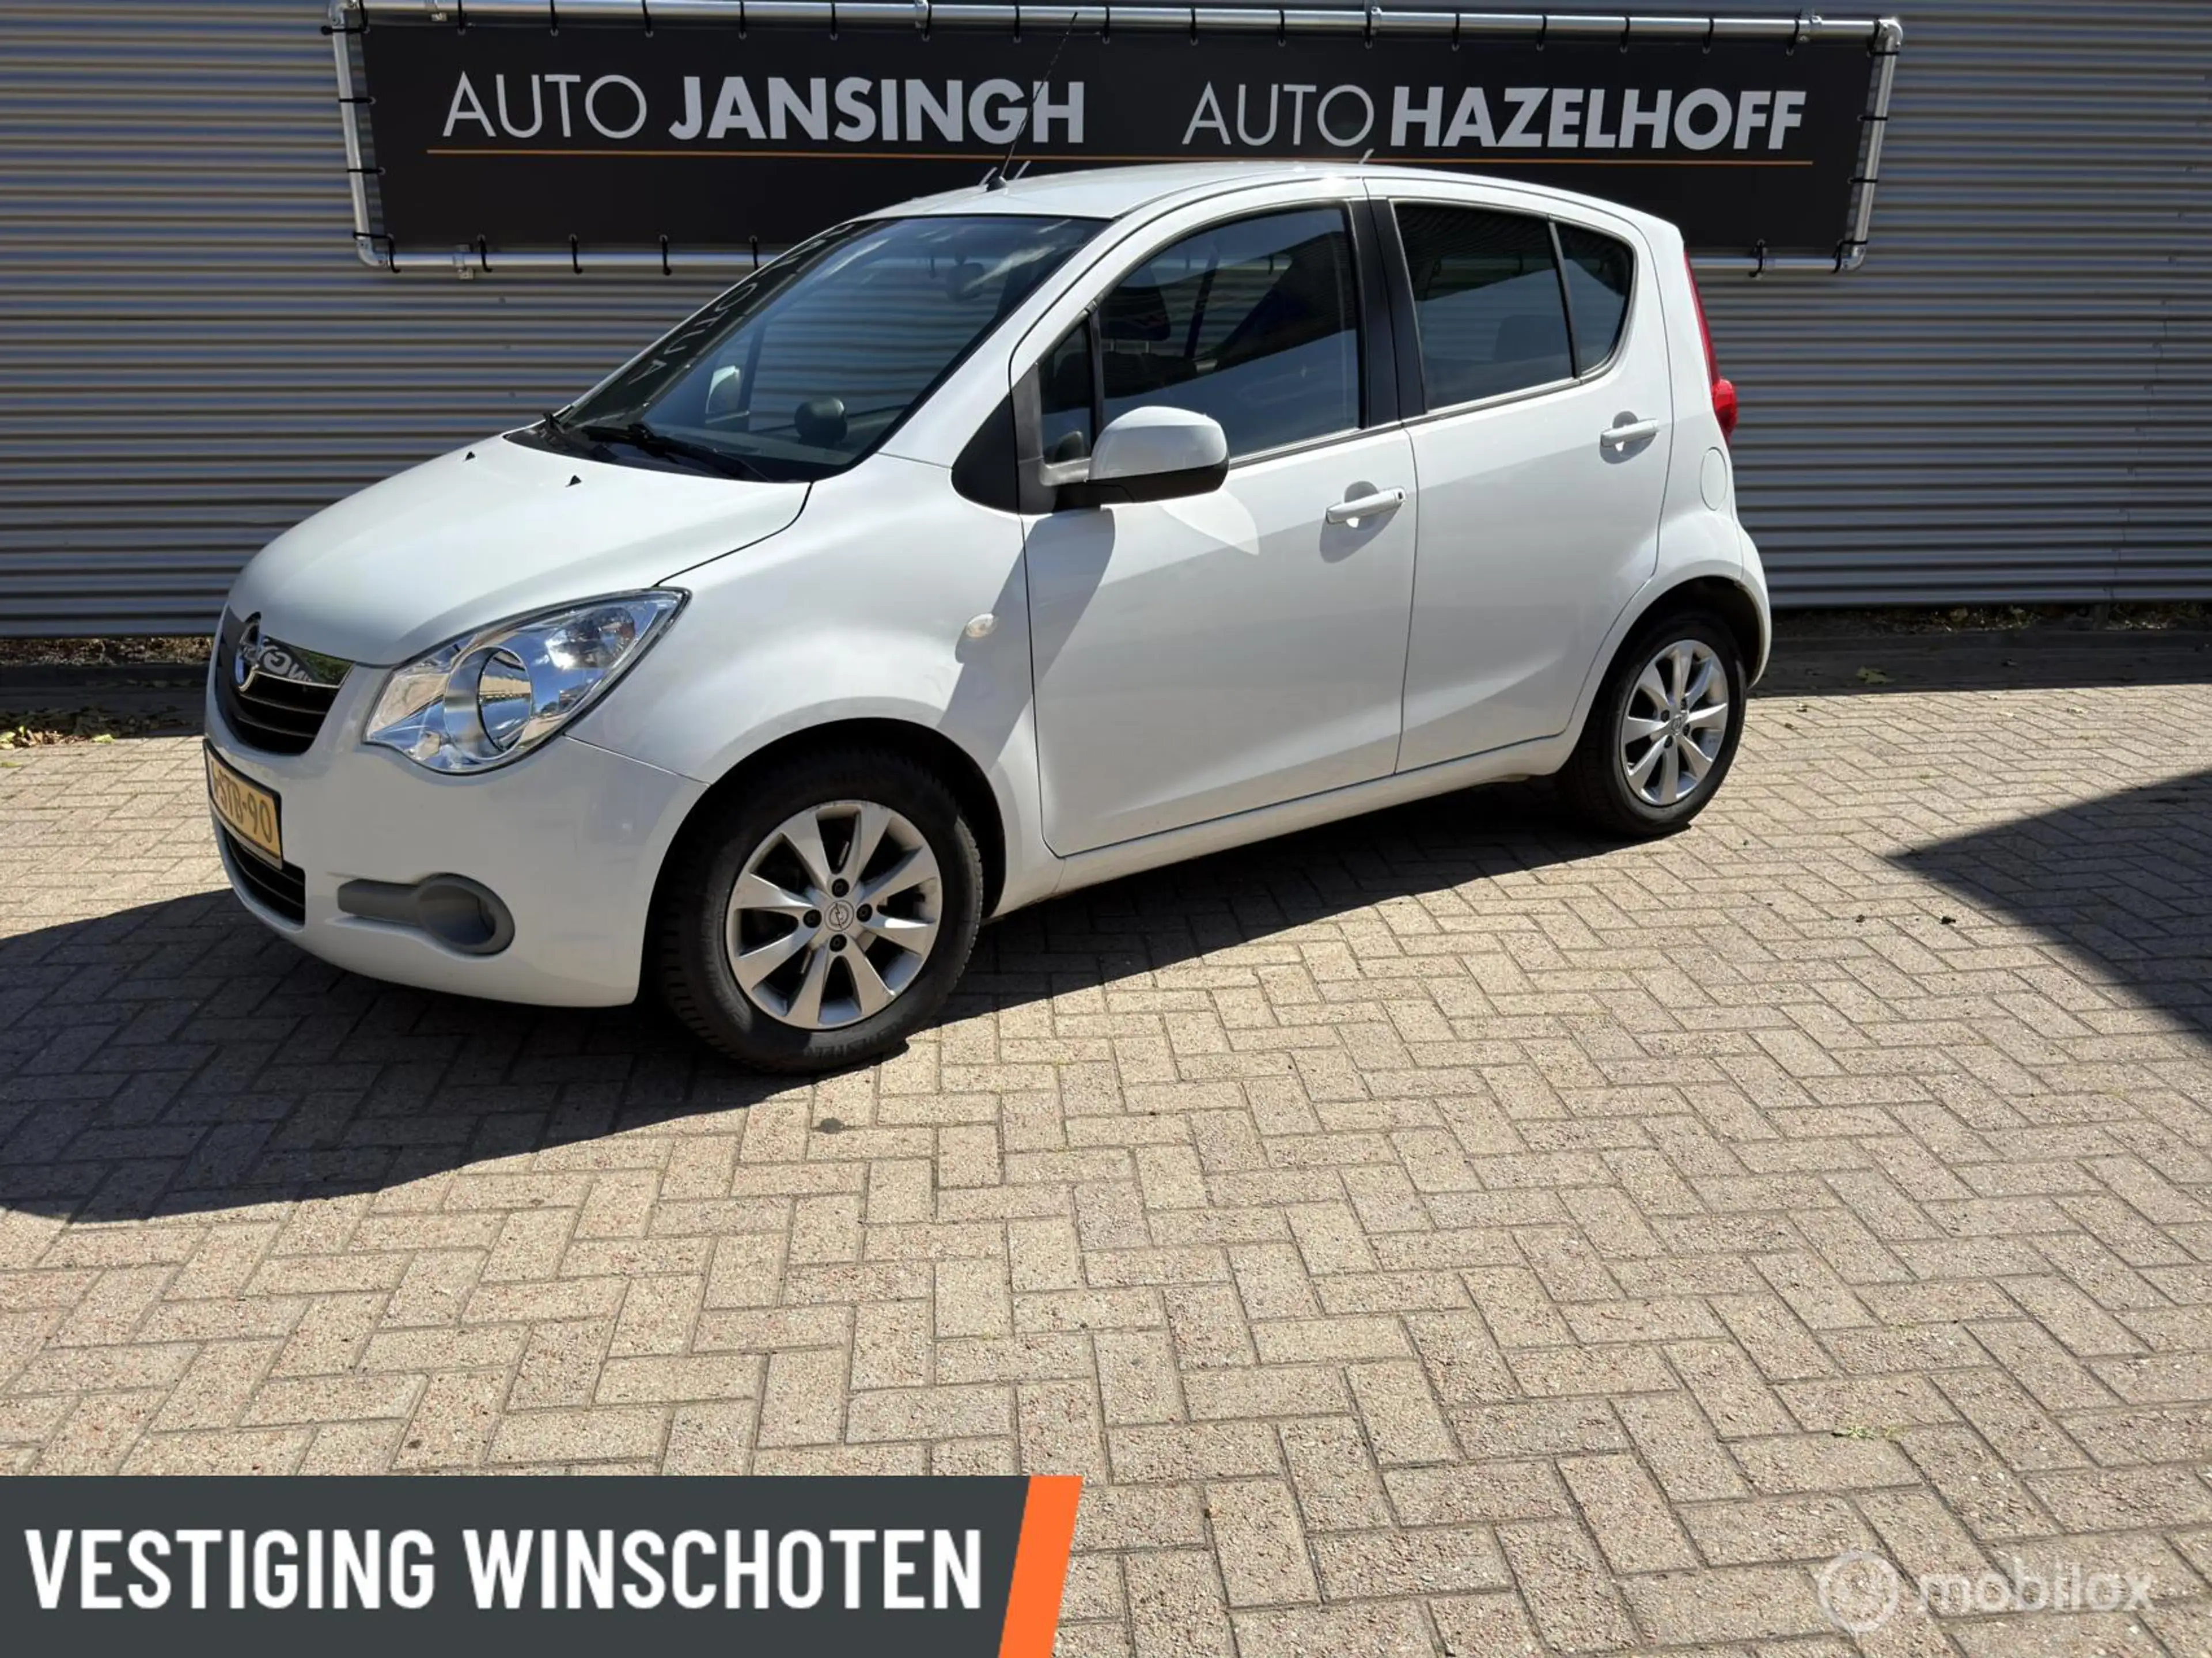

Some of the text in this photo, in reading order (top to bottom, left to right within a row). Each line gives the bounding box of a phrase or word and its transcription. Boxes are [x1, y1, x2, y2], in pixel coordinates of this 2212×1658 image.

[442, 71, 1085, 145] AUTO JANSINGH
[1182, 82, 1807, 150] AUTO HAZELHOFF
